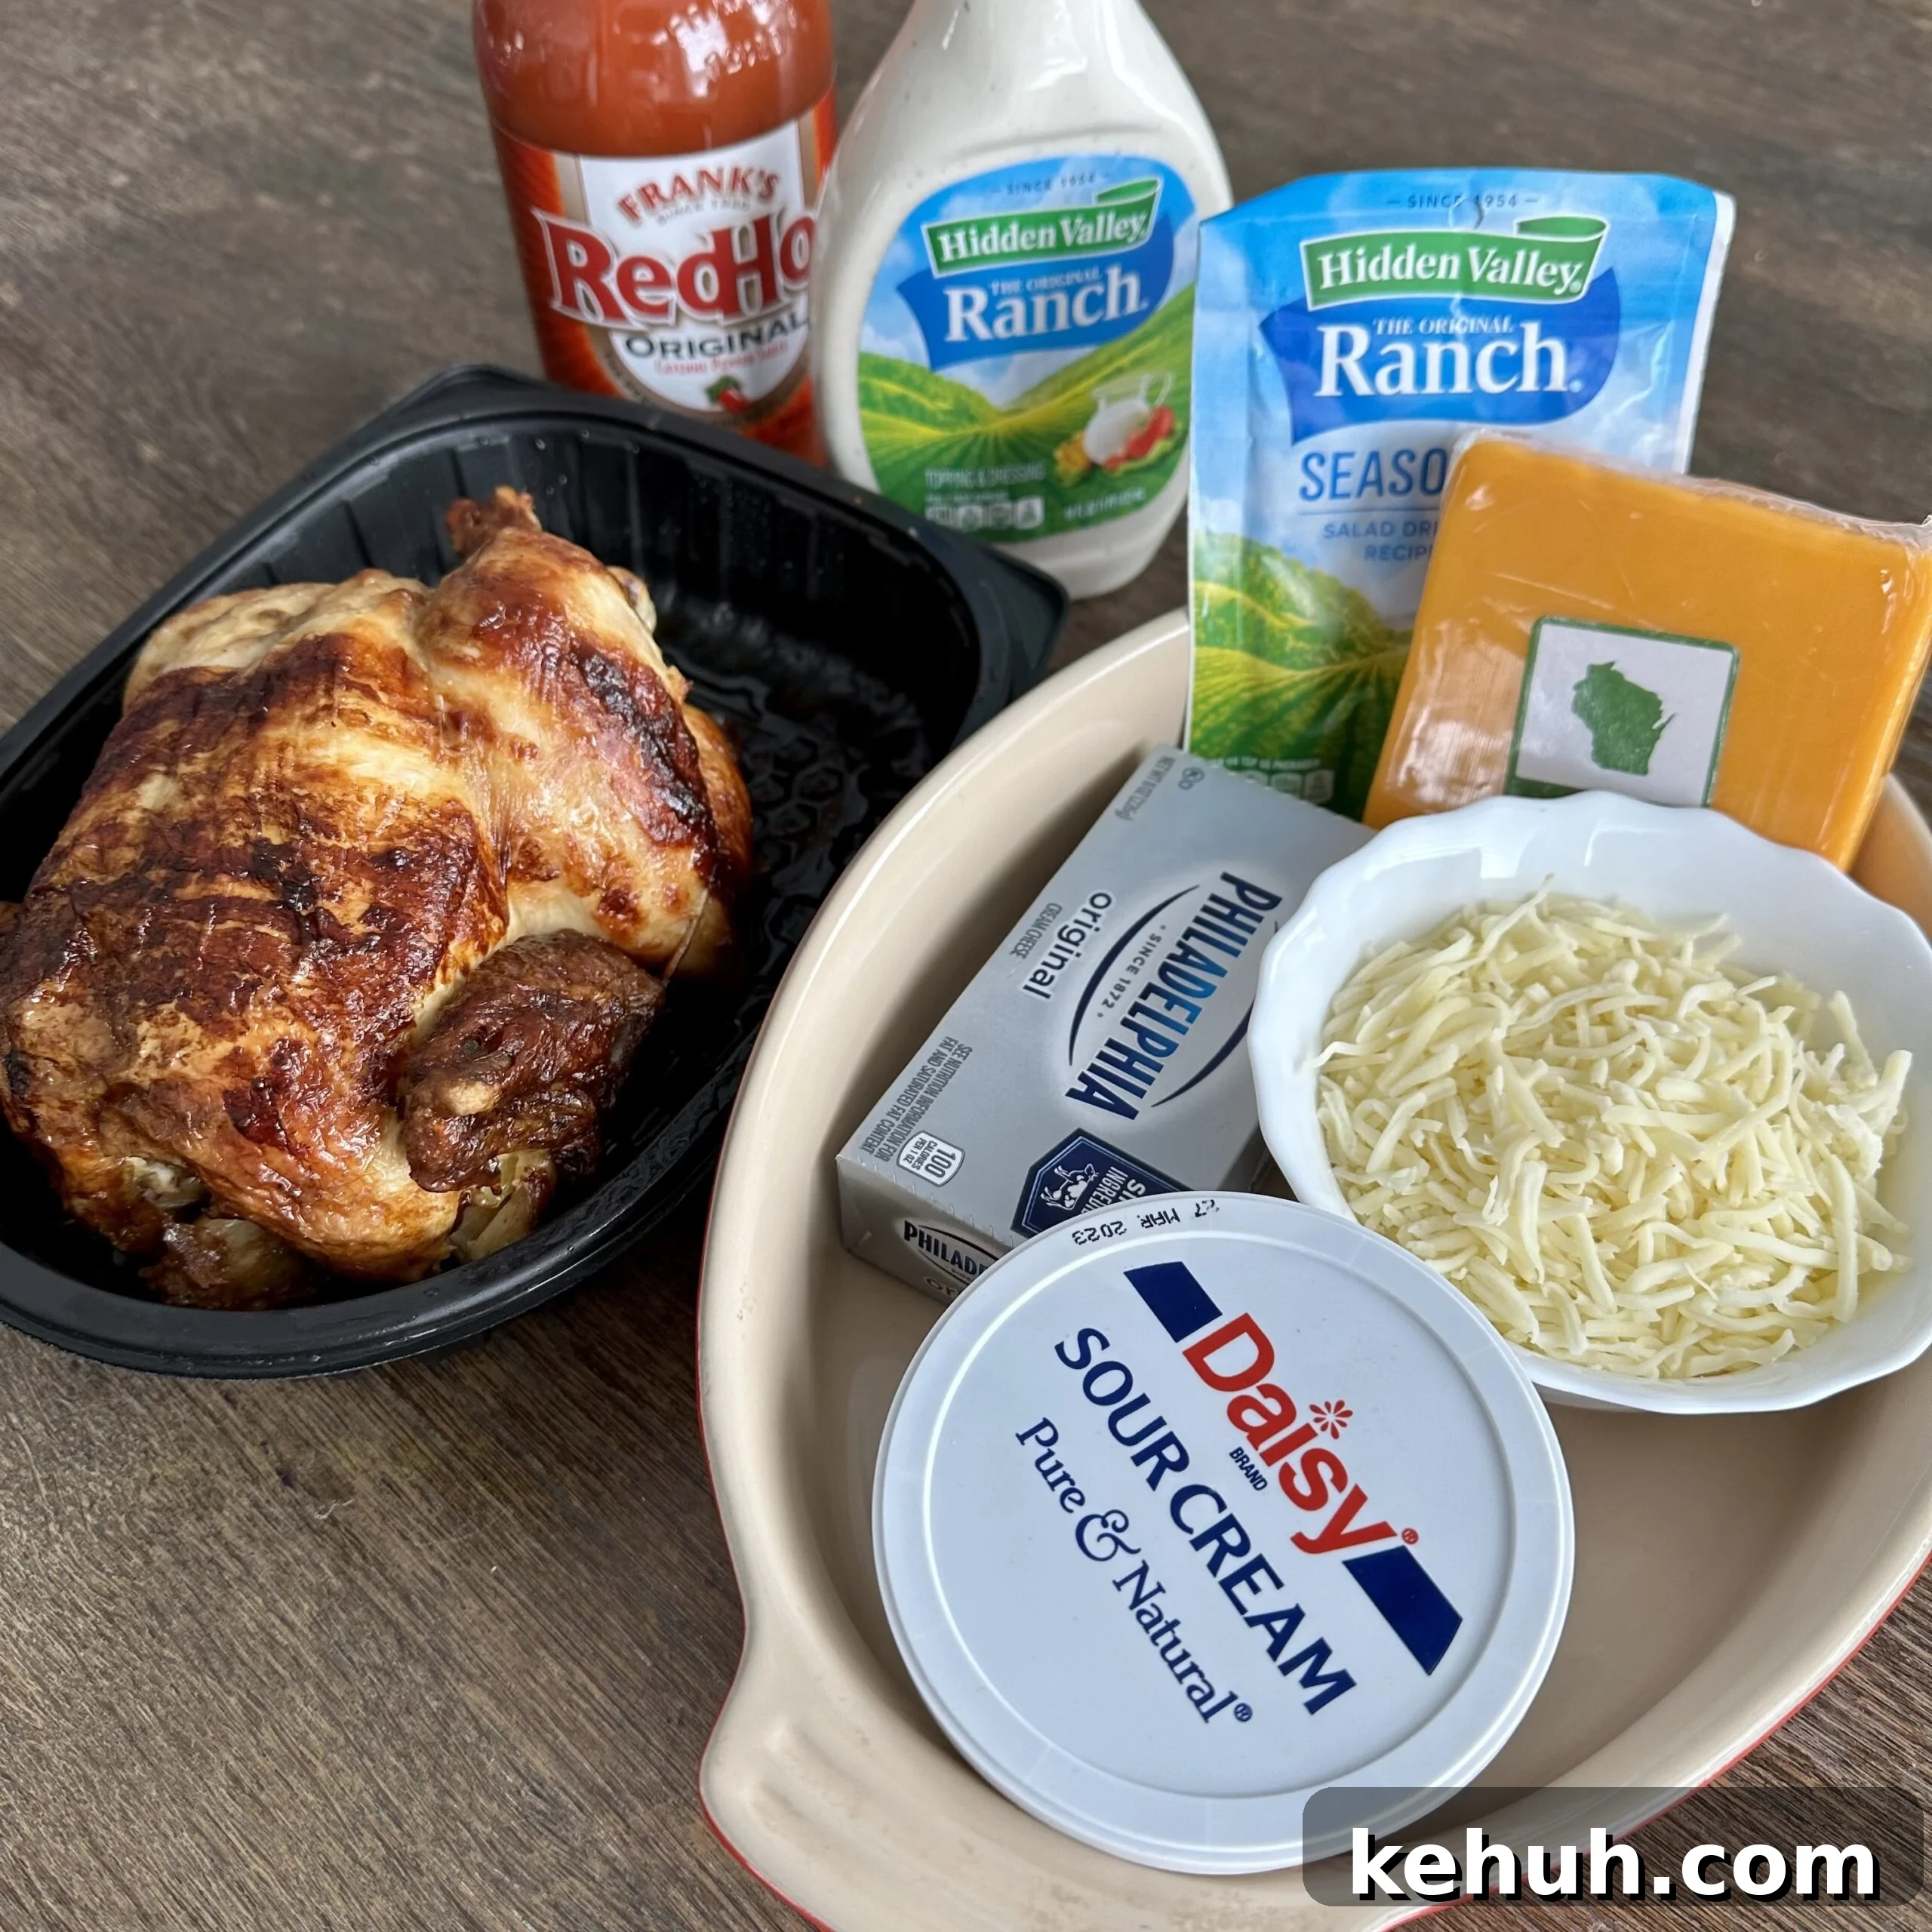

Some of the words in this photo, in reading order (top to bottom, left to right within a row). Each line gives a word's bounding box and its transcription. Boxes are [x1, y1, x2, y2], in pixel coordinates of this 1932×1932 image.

[617, 166, 780, 223] FRANK'S
[1407, 194, 1462, 208] SINCE
[937, 220, 1057, 263] Hidden
[1059, 211, 1148, 248] Valley
[990, 278, 1023, 296] THE
[1026, 266, 1101, 292] ORIGINAL
[1318, 242, 1461, 289] Hidden
[944, 263, 1142, 343] Ranch
[626, 313, 810, 361] ORIGINAL
[1373, 316, 1415, 336] THE
[1418, 313, 1516, 335] ORIGINAL
[1314, 320, 1569, 397] Ranch
[1299, 448, 1448, 502] SEASO
[1323, 521, 1394, 540] SALAD
[1031, 902, 1063, 931] CREAM
[1009, 928, 1043, 960] CHEESE
[1023, 892, 1112, 999] original
[1125, 933, 1162, 975] SINCE
[1065, 871, 1283, 1121] PHILADELPHIA
[1101, 977, 1131, 1010] 1872
[927, 1049, 949, 1068] AND
[938, 1036, 958, 1053] FAT
[952, 1043, 974, 1061] SEE
[896, 1065, 937, 1108] SATURATED
[924, 1057, 963, 1098] NUTRITION
[885, 1104, 906, 1122] FAT
[886, 1094, 935, 1147] INFORMATION
[860, 1118, 896, 1155] CONTENT
[874, 1143, 898, 1162] FOR
[912, 1137, 928, 1150] PER
[903, 1153, 915, 1164] OZ
[911, 1140, 938, 1171] CALORIES
[924, 1148, 956, 1178] 100
[1072, 1220, 1128, 1245] 2023
[1229, 1446, 1269, 1491] BRAND
[1015, 1417, 1086, 1514] Pure
[1075, 1509, 1142, 1562] &
[1054, 1327, 1190, 1491] SOUR
[1169, 1483, 1358, 1715] CREAM
